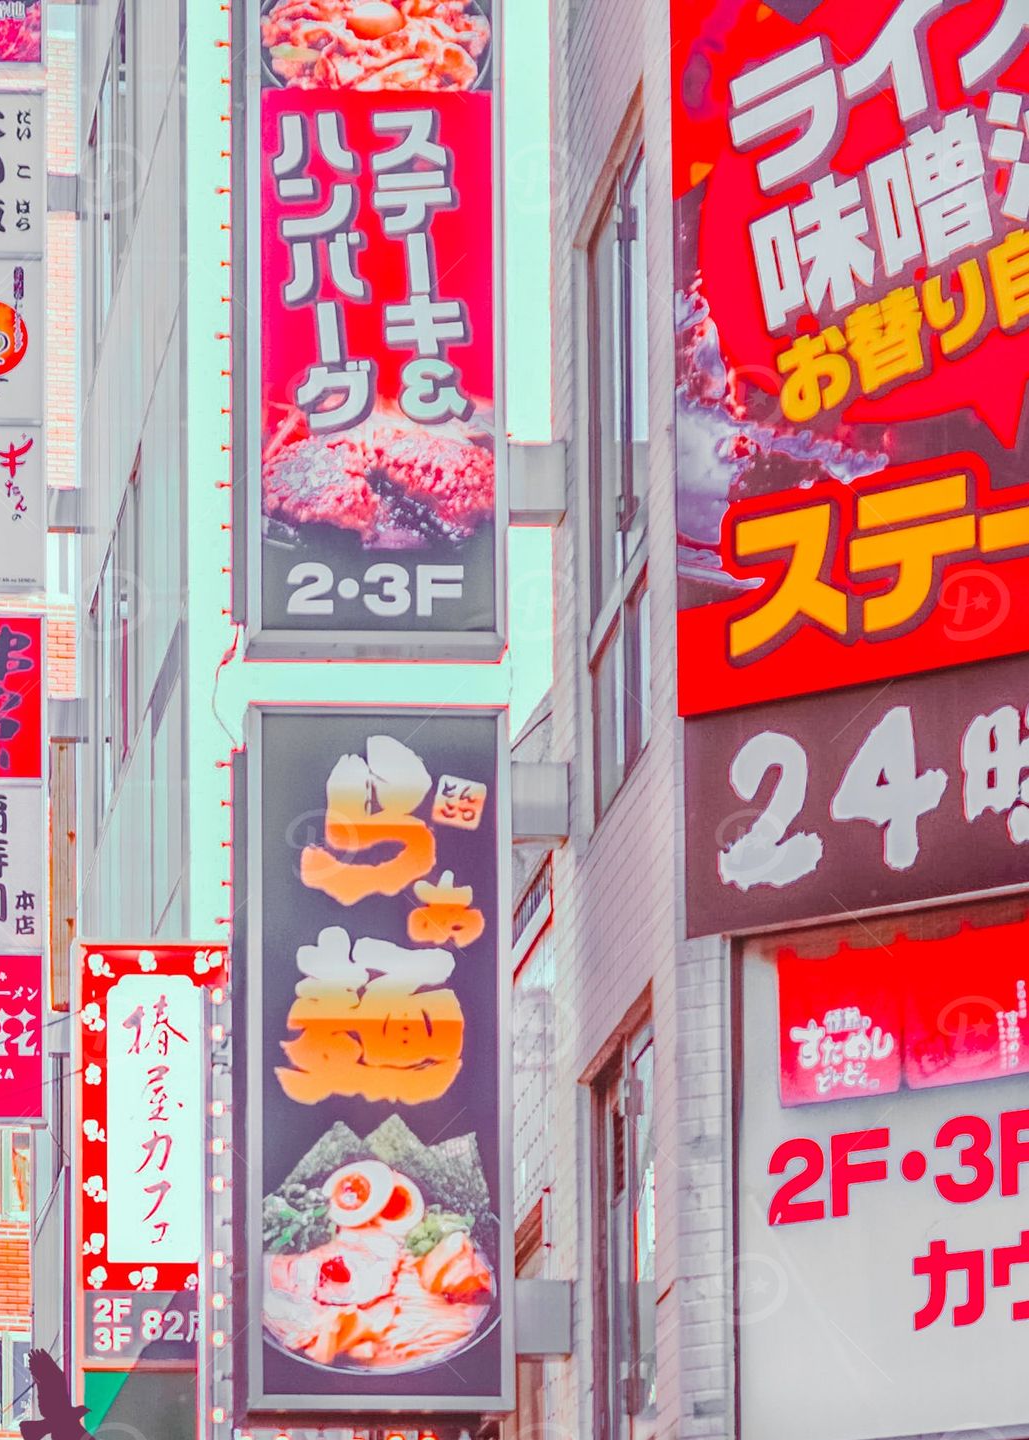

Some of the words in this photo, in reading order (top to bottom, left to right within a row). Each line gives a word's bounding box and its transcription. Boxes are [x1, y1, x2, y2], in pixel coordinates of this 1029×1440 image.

[273, 111, 371, 430] ハンバーグ
[15, 890, 35, 935] 本店
[93, 1299, 132, 1324] 2F
[93, 1327, 132, 1351] 3F
